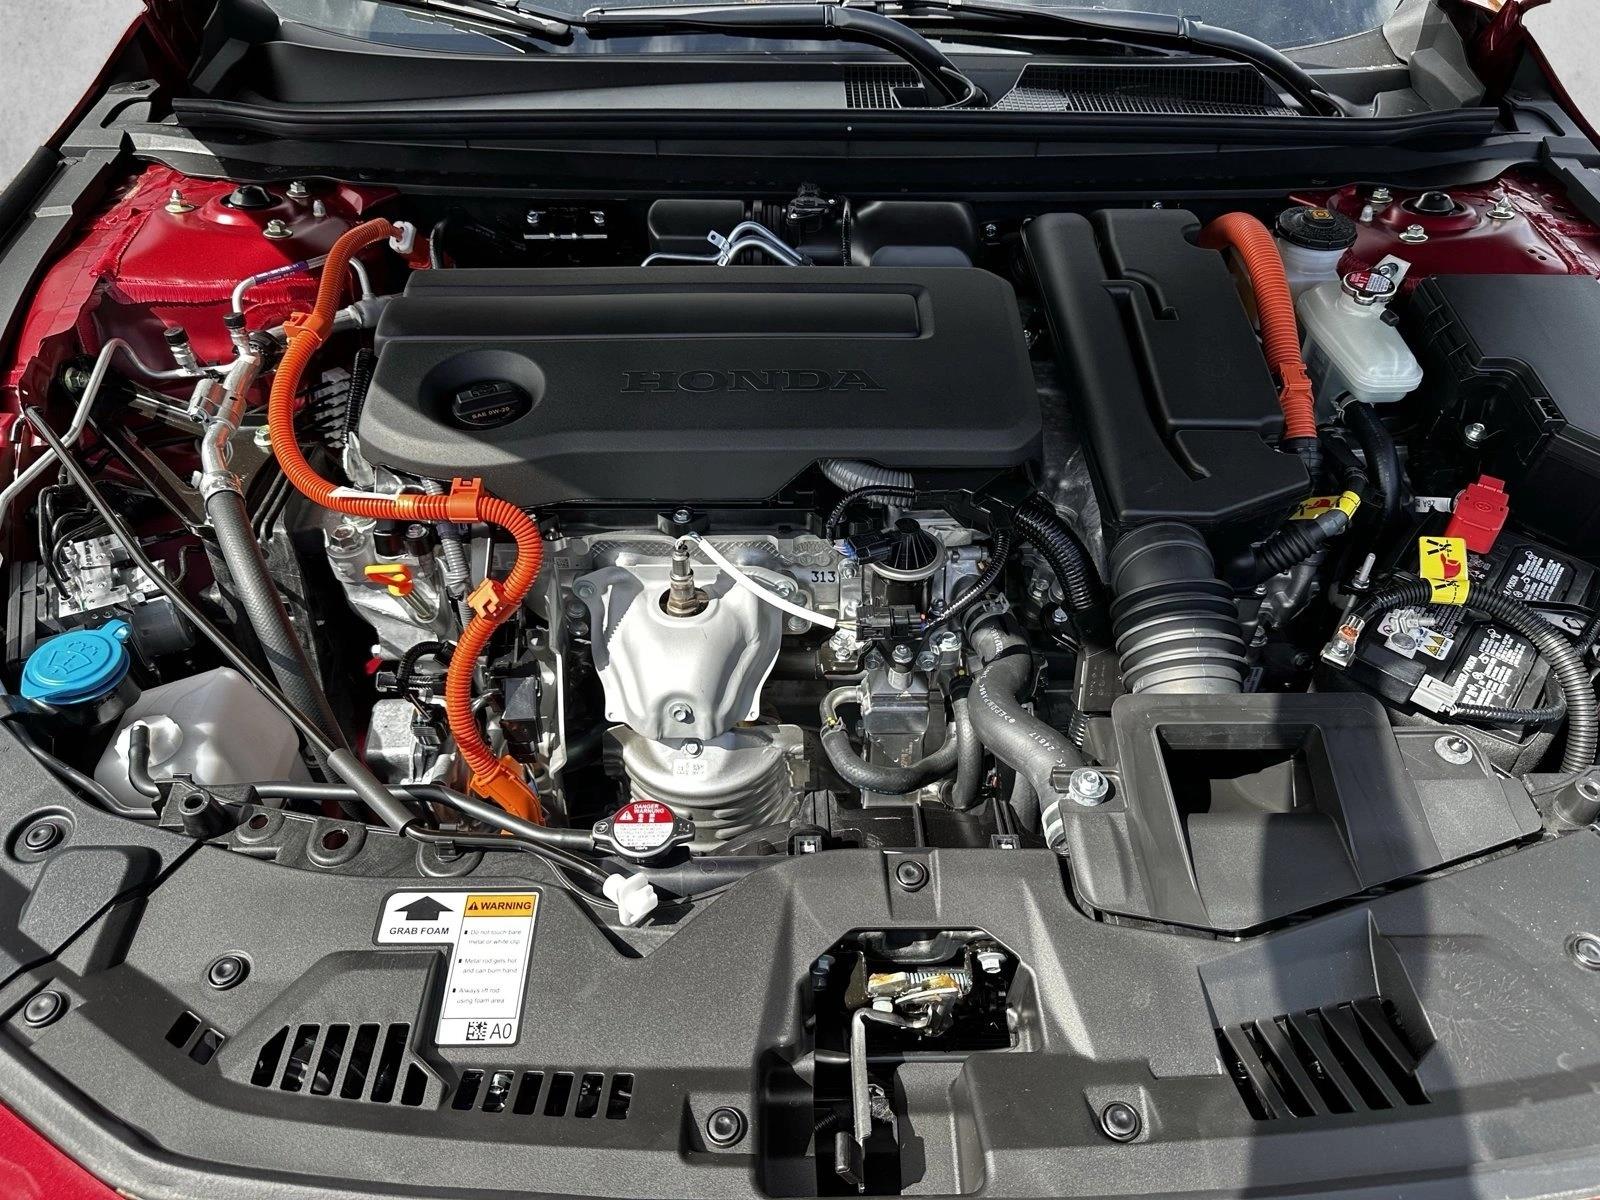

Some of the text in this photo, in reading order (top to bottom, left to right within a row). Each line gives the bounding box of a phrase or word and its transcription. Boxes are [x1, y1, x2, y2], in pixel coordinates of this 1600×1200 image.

[620, 368, 887, 392] HONDA
[472, 406, 510, 420] SAE 0W-20
[811, 571, 836, 582] 313
[480, 902, 531, 910] WARNING
[489, 1023, 512, 1039] A0
